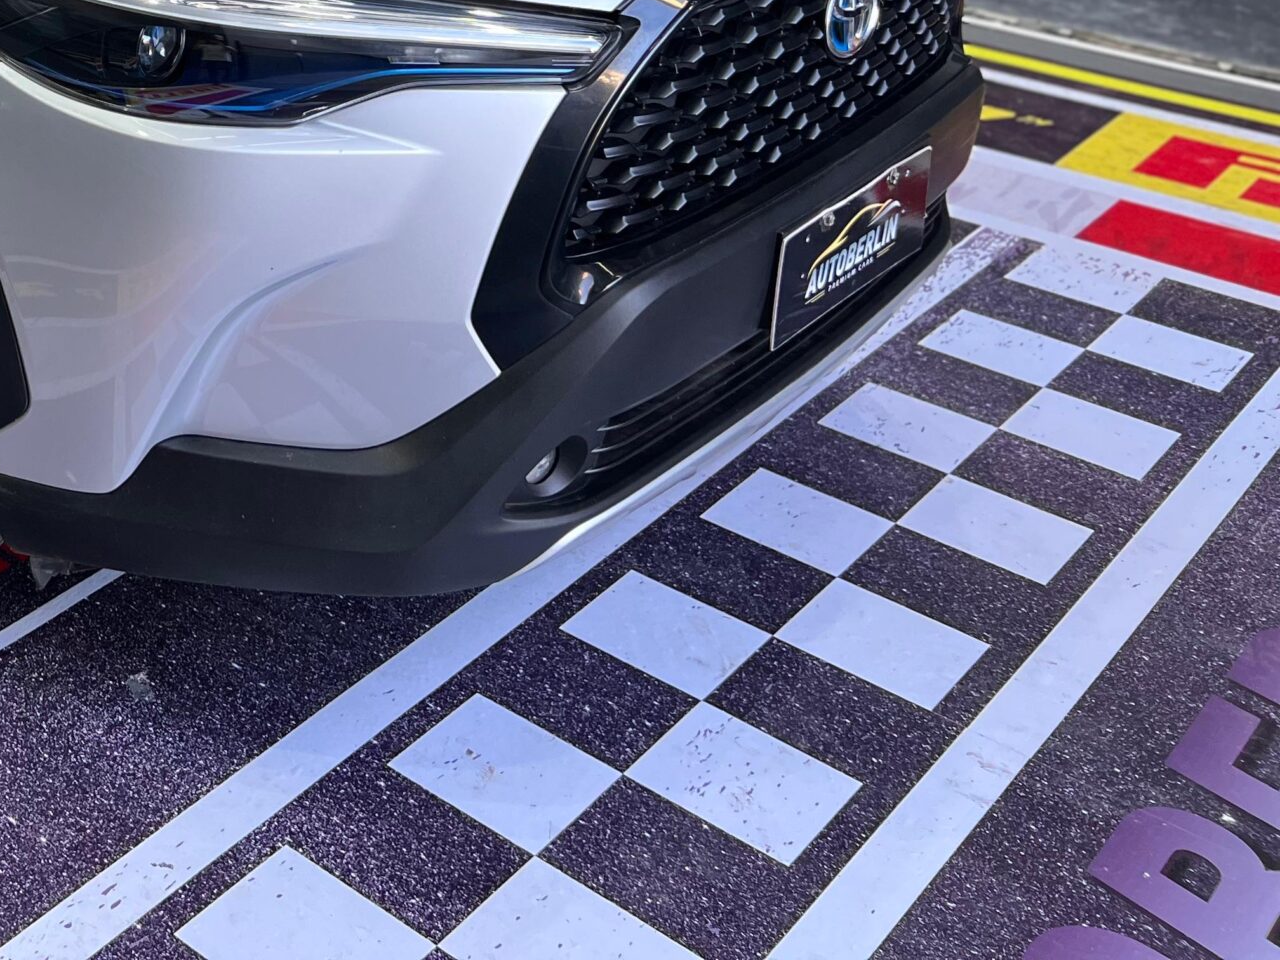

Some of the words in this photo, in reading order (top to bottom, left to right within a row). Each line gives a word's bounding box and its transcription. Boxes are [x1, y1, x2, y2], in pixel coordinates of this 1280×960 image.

[805, 213, 899, 299] AUTOBERLIN
[827, 268, 857, 293] PREMIUM
[857, 256, 875, 271] CARS
